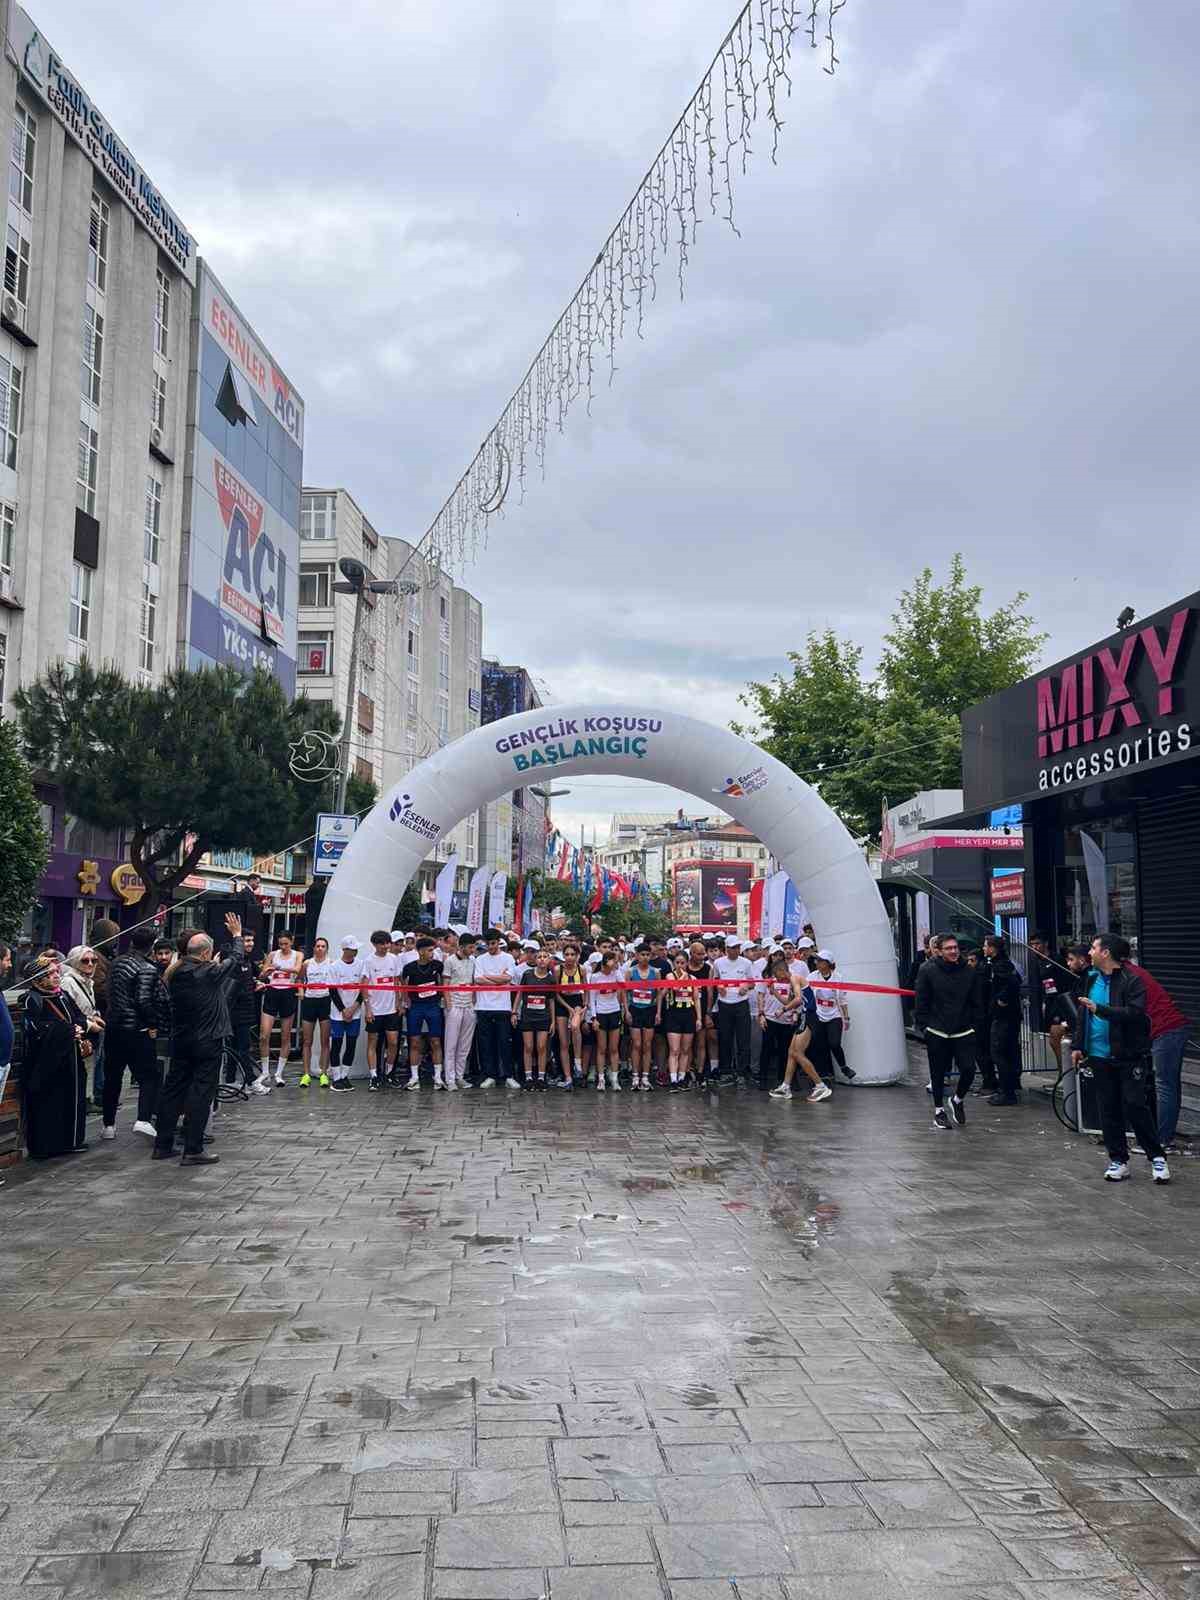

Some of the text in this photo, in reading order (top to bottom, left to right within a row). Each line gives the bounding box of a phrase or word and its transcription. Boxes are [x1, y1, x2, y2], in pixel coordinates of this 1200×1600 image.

[89, 111, 136, 187] Sultan
[139, 174, 191, 258] Mehmet
[211, 297, 266, 393] ESENLER
[219, 465, 259, 517] ESENLER
[1037, 607, 1190, 760] MIXY
[495, 716, 663, 754] GENÇLİK KOŞUSU
[513, 736, 648, 772] BAŞLANGIÇ
[1039, 722, 1192, 792] accessories
[403, 809, 441, 834] ESENLER
